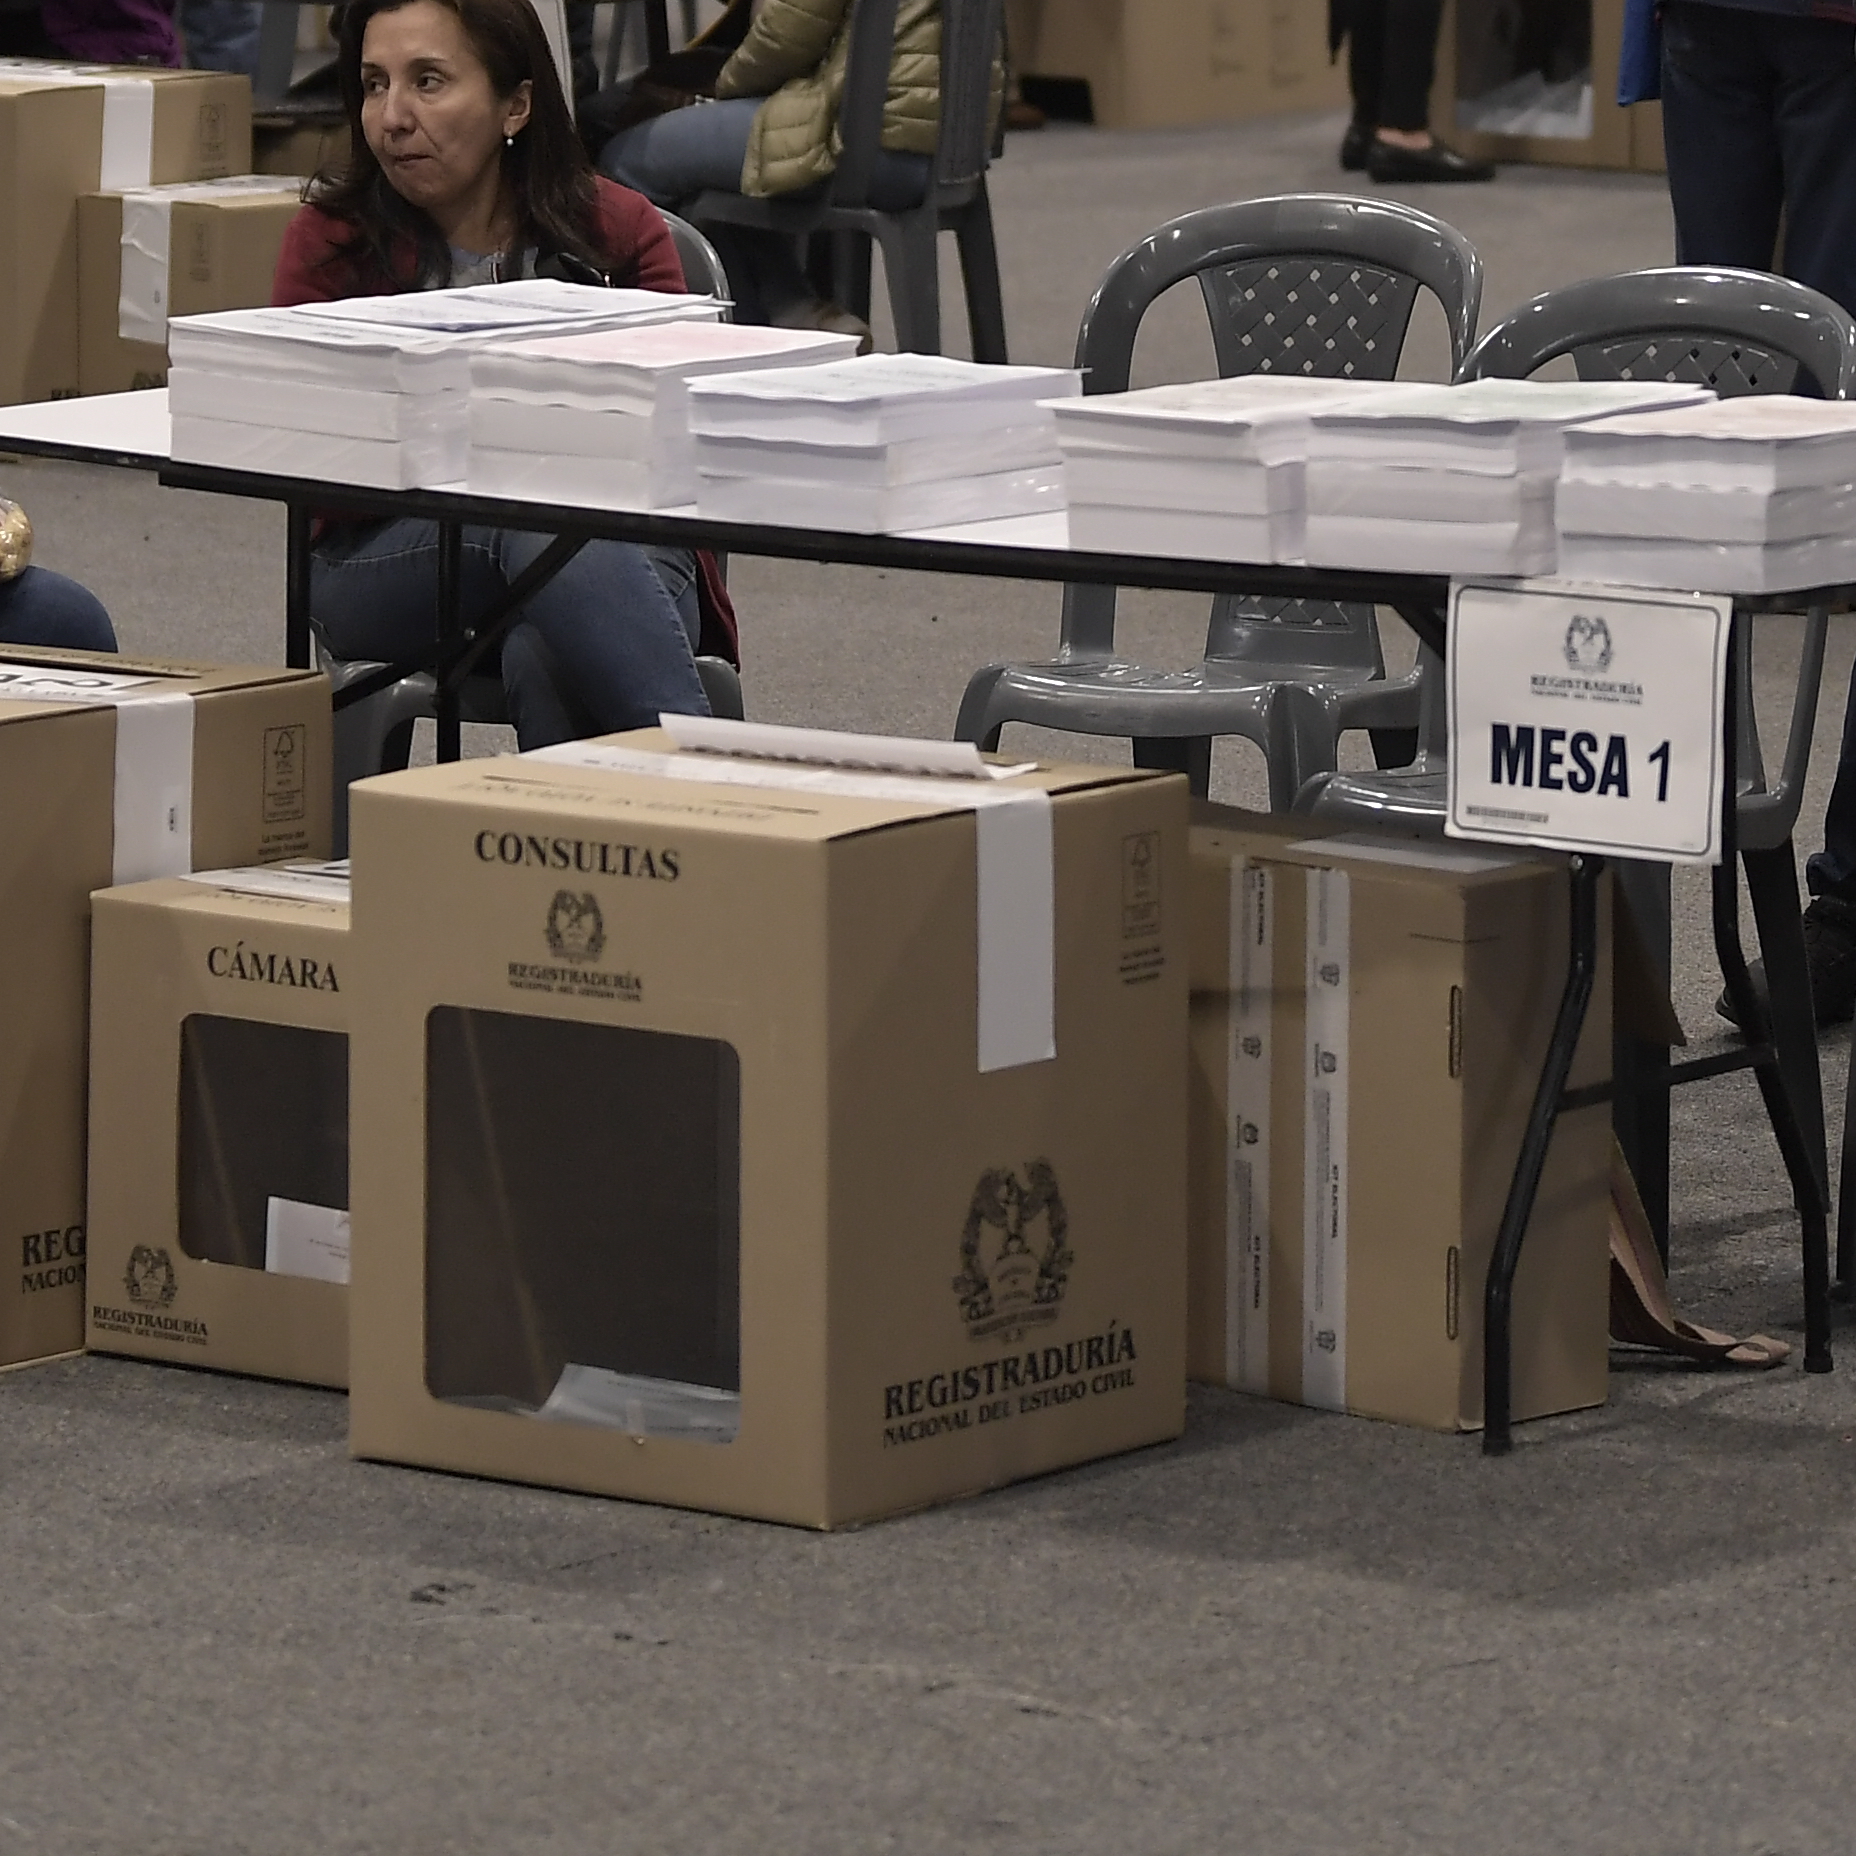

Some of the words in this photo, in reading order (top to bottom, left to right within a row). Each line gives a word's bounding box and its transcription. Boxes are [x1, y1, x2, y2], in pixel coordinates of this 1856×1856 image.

[1491, 723, 1630, 798] MESA
[1648, 741, 1670, 802] 1
[473, 829, 680, 882] CONSULTAS
[207, 942, 340, 995] CÁMARA
[94, 1305, 208, 1336] REGISTRADURÍA
[885, 1319, 1136, 1420] REGISTRADURÍA
[884, 1410, 973, 1448] NACIONAL
[979, 1401, 1011, 1424] DEL
[1020, 1380, 1086, 1413] ESTADO
[1092, 1369, 1135, 1394] CIVIL
